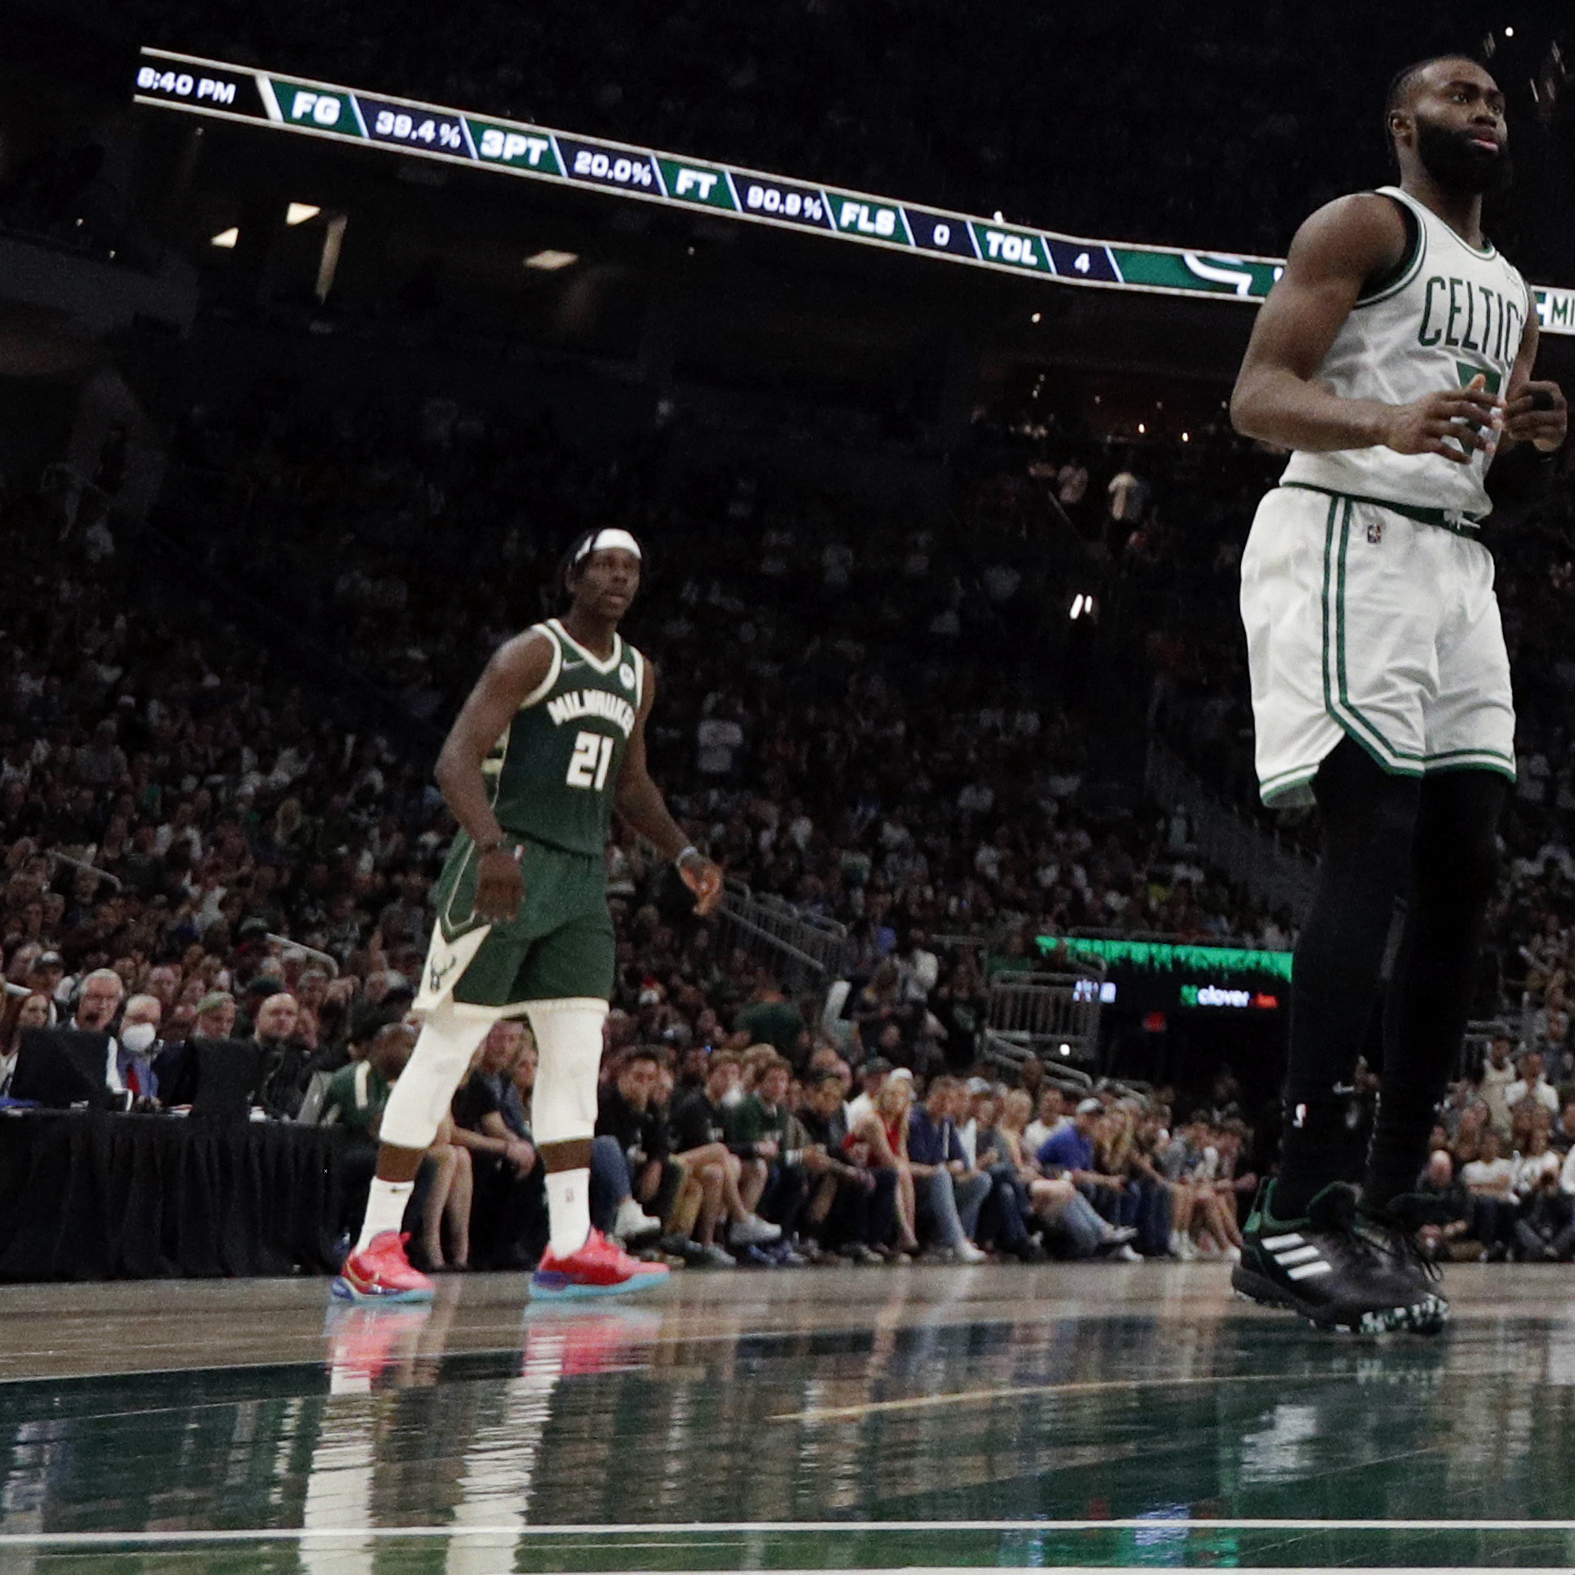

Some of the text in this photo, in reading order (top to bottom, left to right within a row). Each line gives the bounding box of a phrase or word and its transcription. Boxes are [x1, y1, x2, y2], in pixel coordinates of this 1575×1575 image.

[137, 67, 236, 103] 8:40 PM
[292, 91, 341, 125] FG
[480, 130, 549, 165] 3PT
[574, 150, 652, 186] 20.0%
[675, 168, 717, 199] FT
[840, 202, 896, 235] FLS
[933, 224, 950, 245] 0
[986, 232, 1038, 265] TOL
[1074, 253, 1091, 272] 4
[1418, 276, 1522, 370] CELTIC
[566, 731, 614, 791] 21
